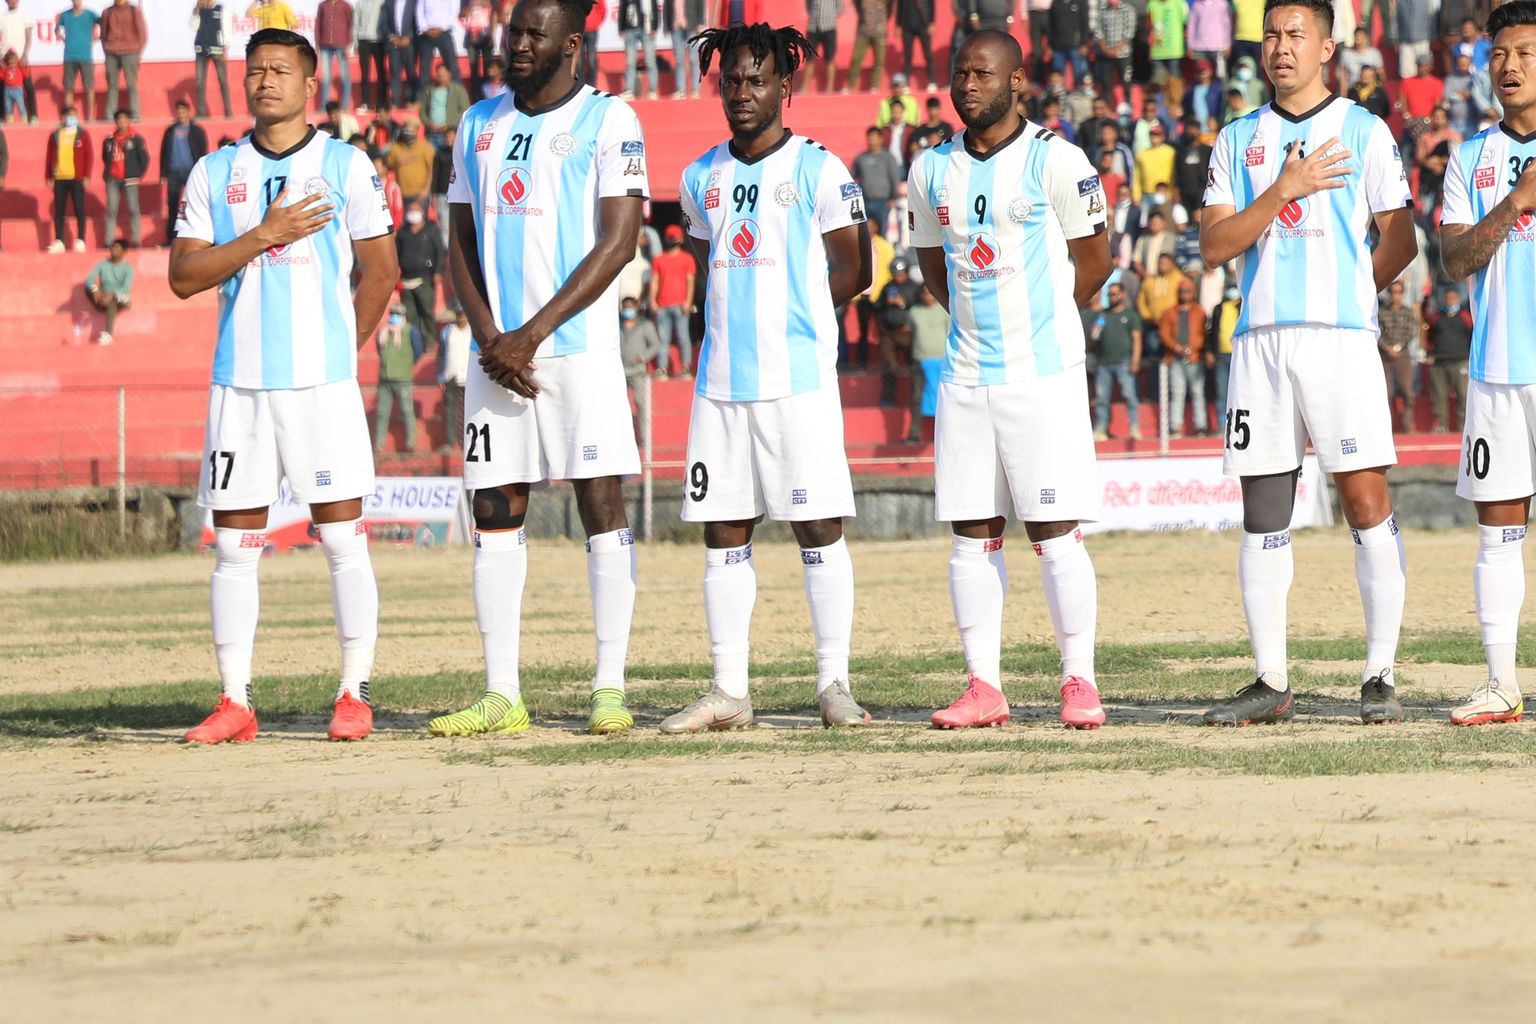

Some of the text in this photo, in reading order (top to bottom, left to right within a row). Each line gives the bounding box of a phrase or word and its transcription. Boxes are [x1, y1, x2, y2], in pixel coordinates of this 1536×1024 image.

[476, 133, 493, 143] KTM
[475, 142, 490, 152] CTY
[506, 133, 533, 161] 21
[1245, 146, 1265, 157] KTM
[1245, 156, 1264, 167] CTY
[1475, 167, 1495, 177] KTM
[227, 183, 247, 194] KTM
[1475, 178, 1495, 189] CTY
[705, 188, 720, 198] KTM
[732, 183, 759, 213] 99
[227, 194, 247, 204] CTY
[704, 199, 720, 210] CTY
[484, 205, 497, 215] EPAL
[505, 206, 544, 217] CORPORATION
[974, 194, 987, 224] 9
[1283, 229, 1325, 239] CORPORATION
[269, 256, 310, 267] CORPORATION
[728, 258, 737, 268] OIL
[737, 257, 777, 268] CORPORATION
[976, 266, 1016, 279] CORPORATION
[1225, 407, 1251, 451] 15
[465, 422, 492, 462] 21
[1342, 446, 1357, 454] CTY
[1464, 434, 1491, 480] 30
[209, 450, 236, 490] 17
[684, 461, 709, 502] 9
[390, 483, 458, 510] HOUSE
[1040, 488, 1055, 496] KTM
[792, 497, 807, 505] CTY
